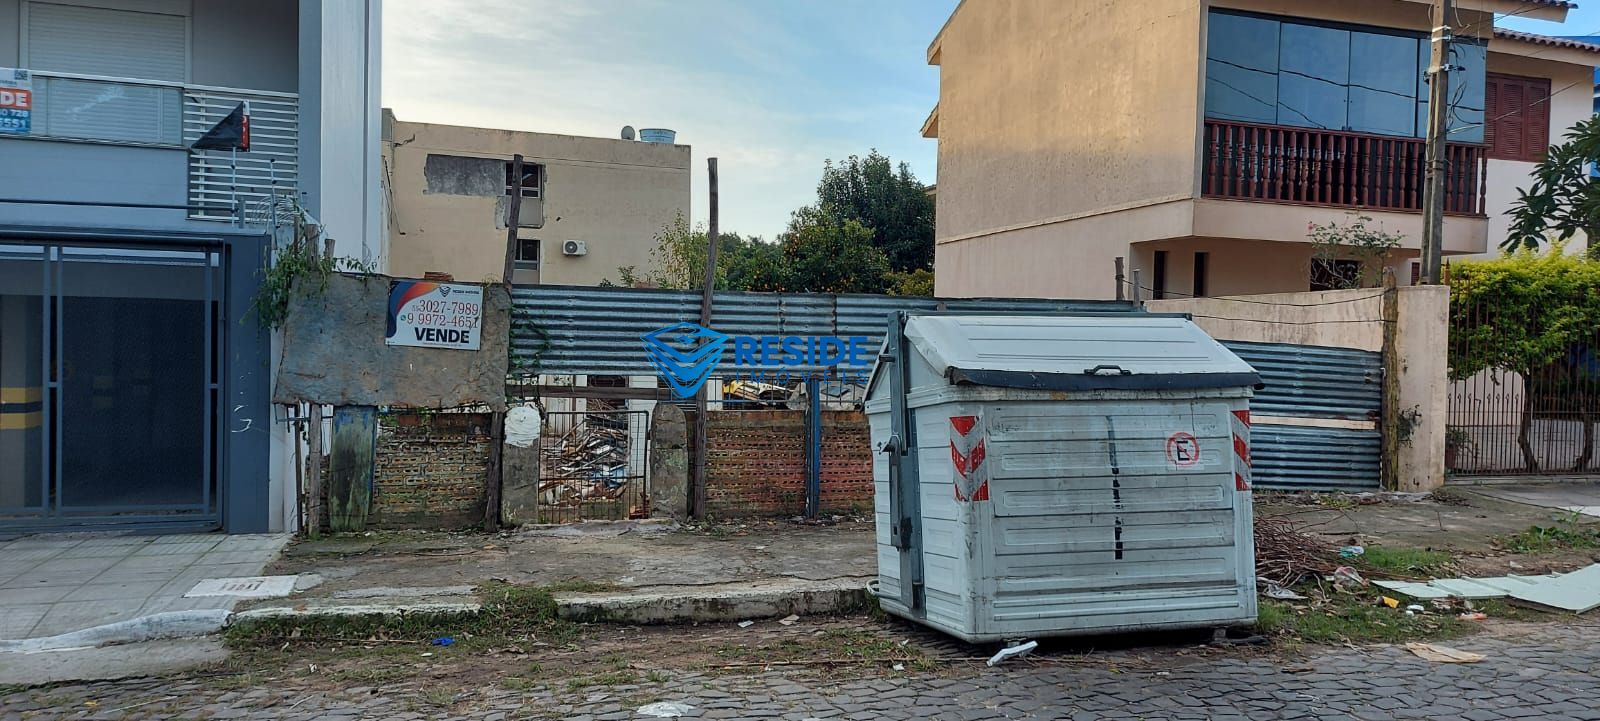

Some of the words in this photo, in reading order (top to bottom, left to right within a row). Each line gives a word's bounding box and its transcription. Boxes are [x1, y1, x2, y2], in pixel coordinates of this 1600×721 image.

[420, 300, 479, 316] 3027-7989
[407, 313, 414, 325] 9
[414, 327, 470, 344] VENDE
[1176, 440, 1190, 461] E
